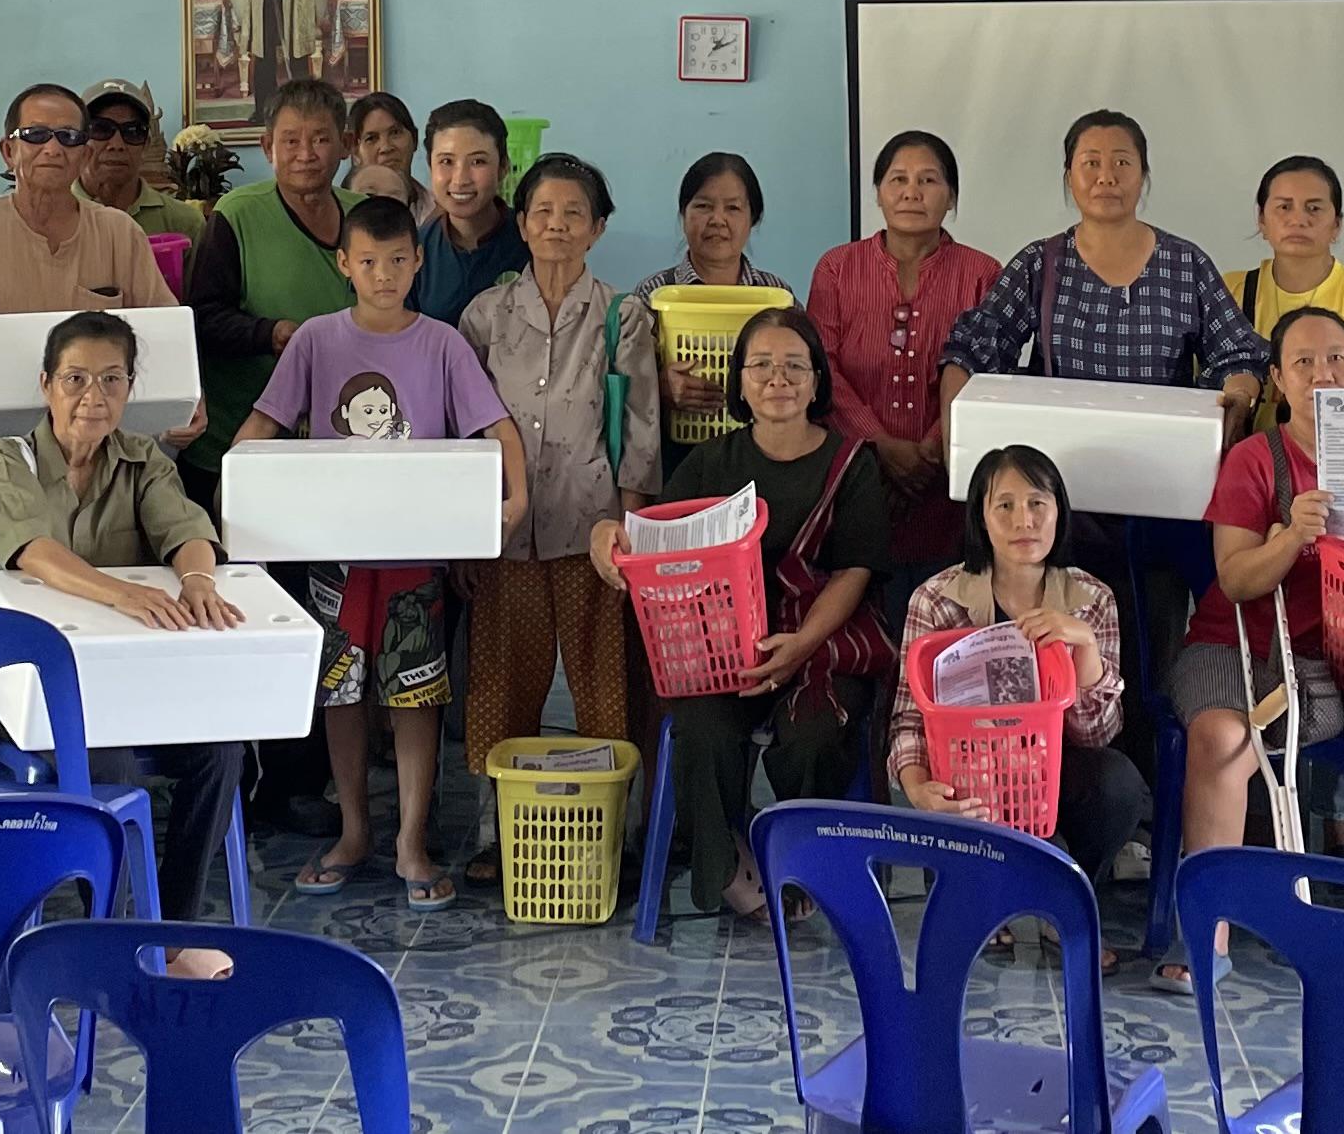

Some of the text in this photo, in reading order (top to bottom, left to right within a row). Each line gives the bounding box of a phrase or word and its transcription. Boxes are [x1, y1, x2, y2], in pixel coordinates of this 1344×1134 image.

[322, 653, 355, 690] HULK
[402, 669, 428, 682] THE
[910, 833, 935, 847] ม.27
